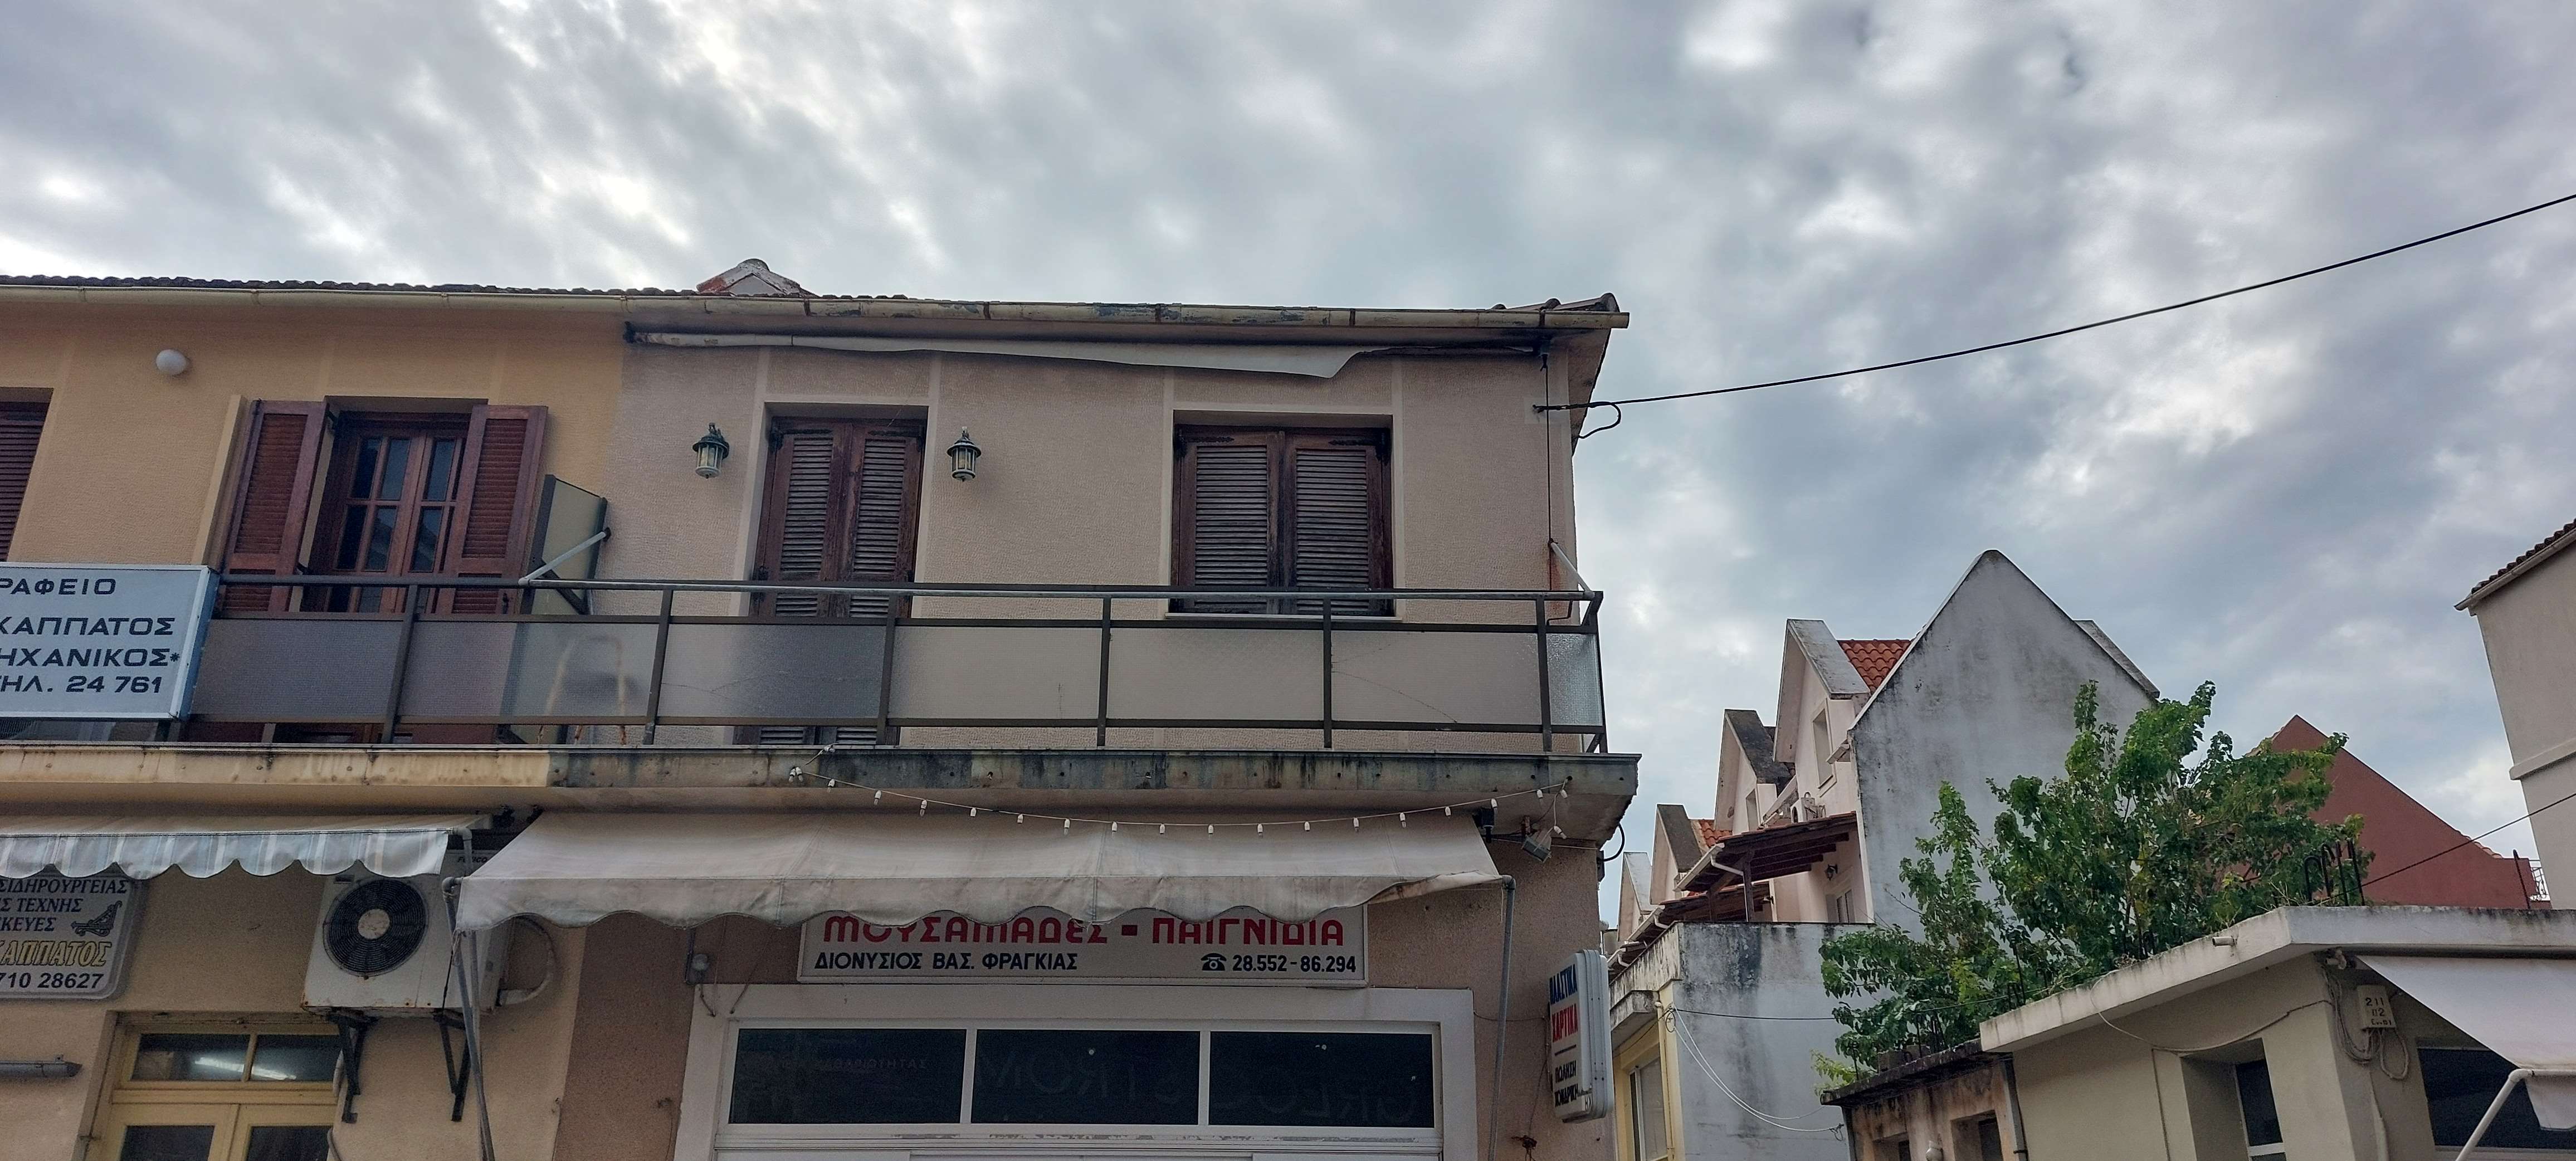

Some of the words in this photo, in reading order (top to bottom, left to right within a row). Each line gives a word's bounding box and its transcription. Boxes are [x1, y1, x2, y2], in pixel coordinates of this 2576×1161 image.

[0, 675, 53, 692] ΗΛ.
[66, 676, 105, 692] 24
[115, 676, 162, 693] 761
[17, 897, 84, 913] ΤΕΧΝΗΣ
[0, 916, 56, 931] ΚΕΥΕΣ
[1153, 918, 1344, 946] ΠΑΙΓΝΙΔΙΑ
[0, 940, 112, 967] ΑΠΠΑΤΟΣ
[814, 952, 923, 970] ΔΙΟΝΥΣΙΟΣ
[933, 953, 974, 970] ΒΑΣ.
[982, 952, 1078, 970] ΦΡΑΓΚΙΑΣ
[37, 972, 105, 989] 28627
[1549, 964, 1578, 1005] ΠΛΑΣΤΙΚΑ
[2365, 997, 2384, 1006] 211
[1552, 1003, 1578, 1043] ΧΑΡΤΙΚΑ
